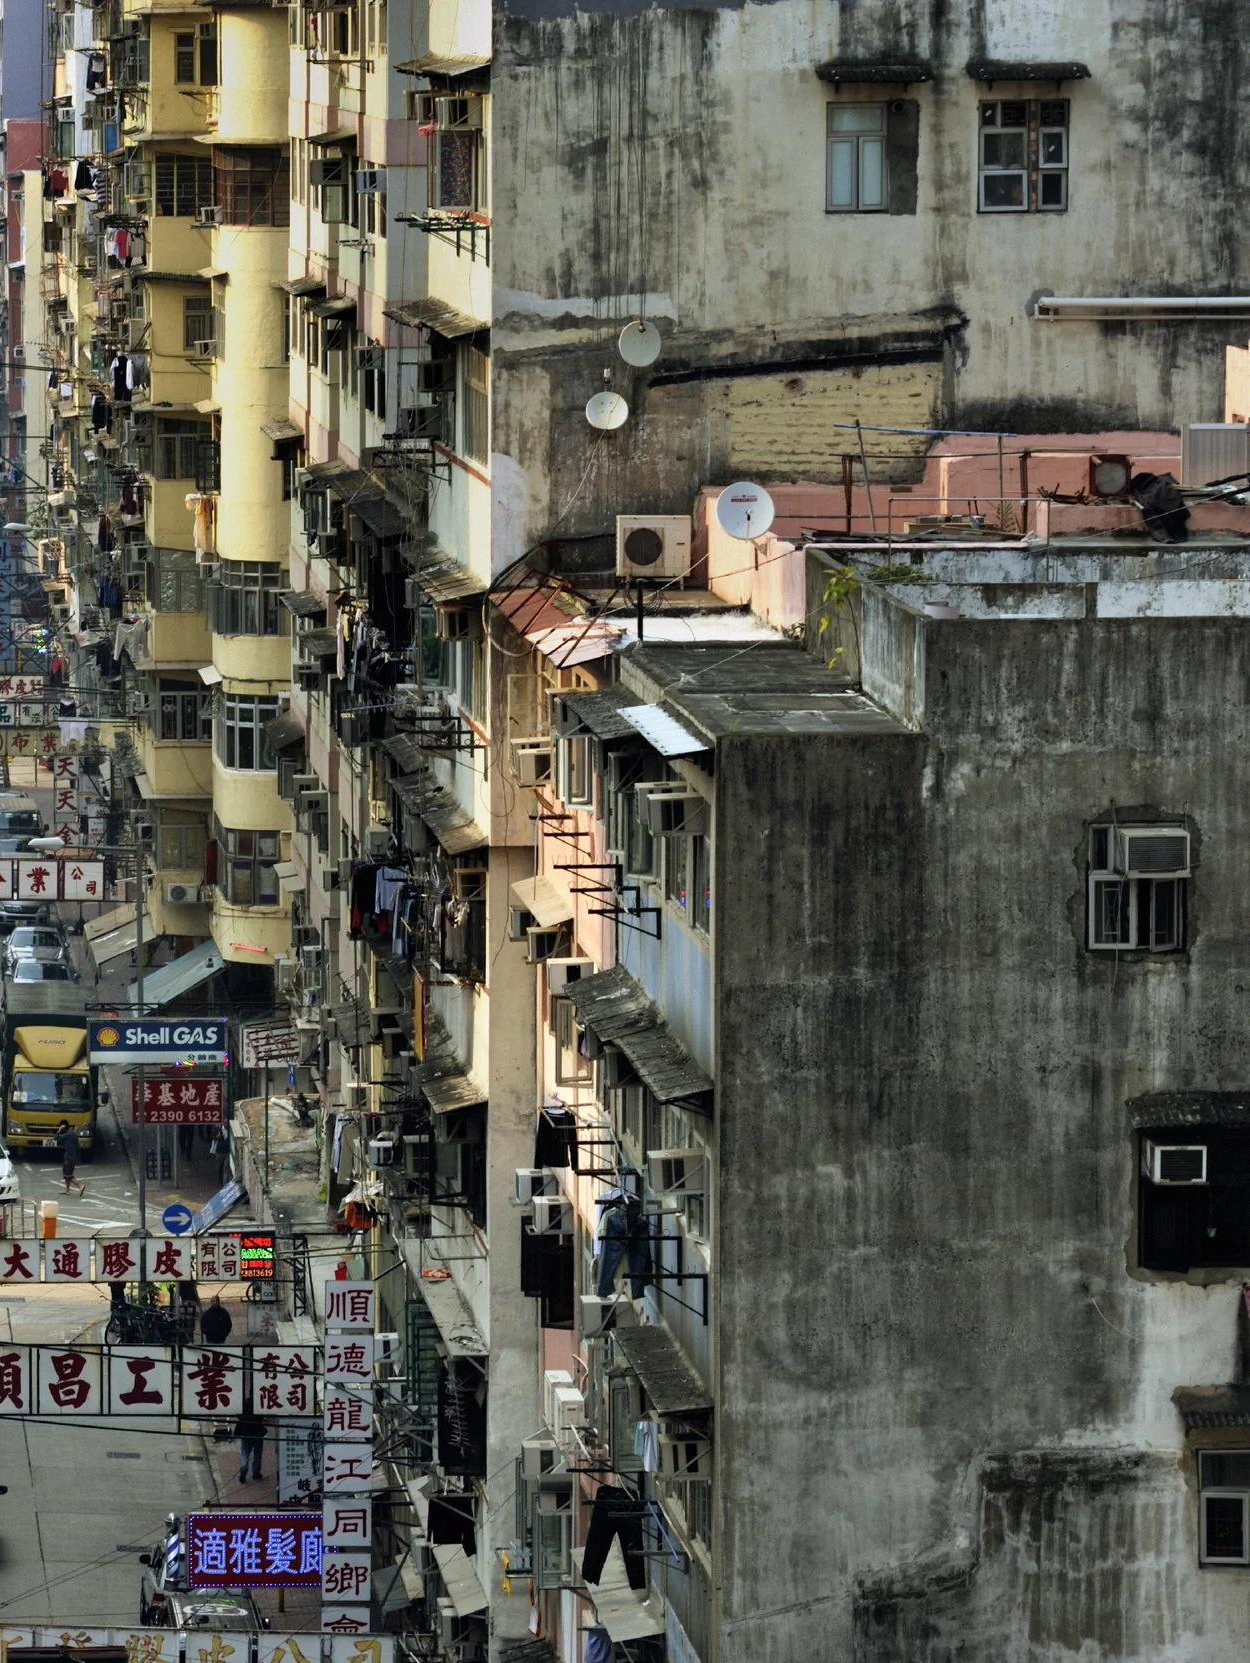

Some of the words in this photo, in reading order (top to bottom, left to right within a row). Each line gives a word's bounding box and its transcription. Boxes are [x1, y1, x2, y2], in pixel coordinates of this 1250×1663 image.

[125, 1027, 170, 1045] Shell
[173, 1027, 218, 1045] GAS
[150, 1111, 184, 1122] 2390
[188, 1111, 220, 1122] 6132
[2, 1240, 238, 1279] 大通膠皮有限公司
[193, 1526, 323, 1576] 適雅髮廊
